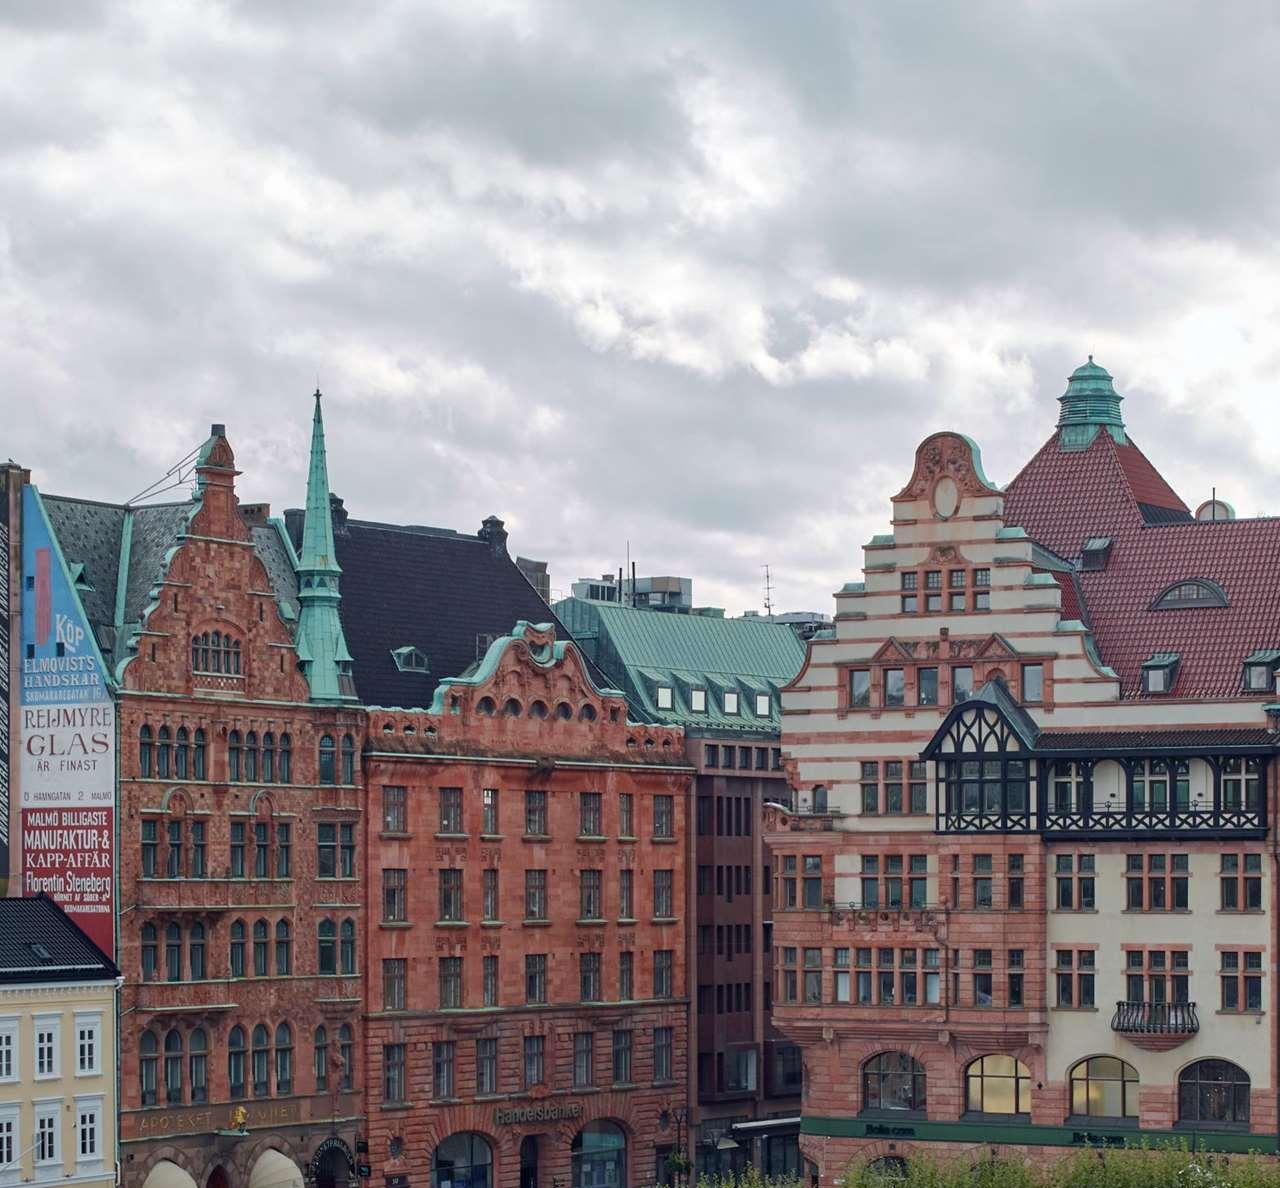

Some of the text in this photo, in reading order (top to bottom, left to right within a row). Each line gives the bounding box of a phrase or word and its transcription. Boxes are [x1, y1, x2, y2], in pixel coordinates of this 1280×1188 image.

[0, 697, 10, 755] GENOM
[24, 707, 112, 729] REIJMYRE
[26, 732, 110, 756] GLAS
[60, 759, 98, 772] FINAST
[0, 757, 10, 846] ANNONSERA
[77, 790, 86, 801] 2
[27, 811, 108, 827] MALMÖ BILLIGASTE
[25, 851, 111, 868] KAPP-AFFÄR
[26, 871, 111, 899] Florentin Steneberg
